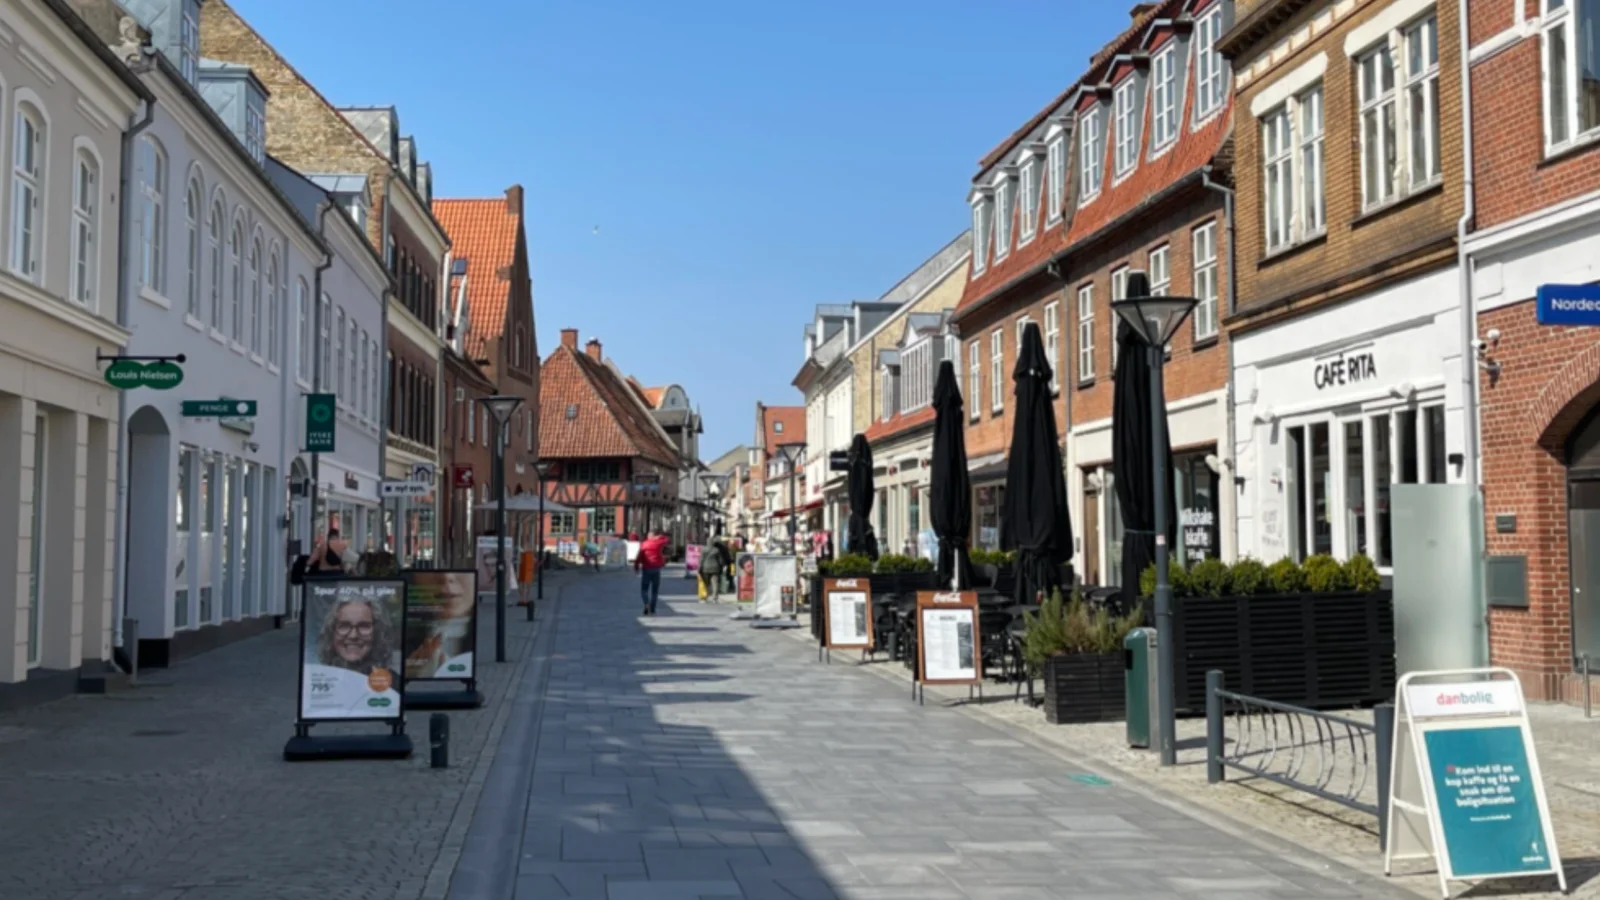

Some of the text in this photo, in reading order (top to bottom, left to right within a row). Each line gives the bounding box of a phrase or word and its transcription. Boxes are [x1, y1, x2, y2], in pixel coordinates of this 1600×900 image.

[1347, 352, 1377, 382] RITA
[110, 369, 178, 380] Louis Nielsen
[199, 404, 229, 412] PENGE
[314, 586, 337, 597] Spar
[339, 586, 361, 596] 40%
[362, 585, 375, 597] på
[1436, 692, 1495, 705] danbolig
[1476, 764, 1490, 774] ind
[1491, 764, 1501, 773] til
[1502, 765, 1514, 773] en
[1445, 773, 1520, 788] kop kaffe og få en
[1459, 785, 1511, 796] snak om din
[1455, 796, 1516, 808] boligsituation
